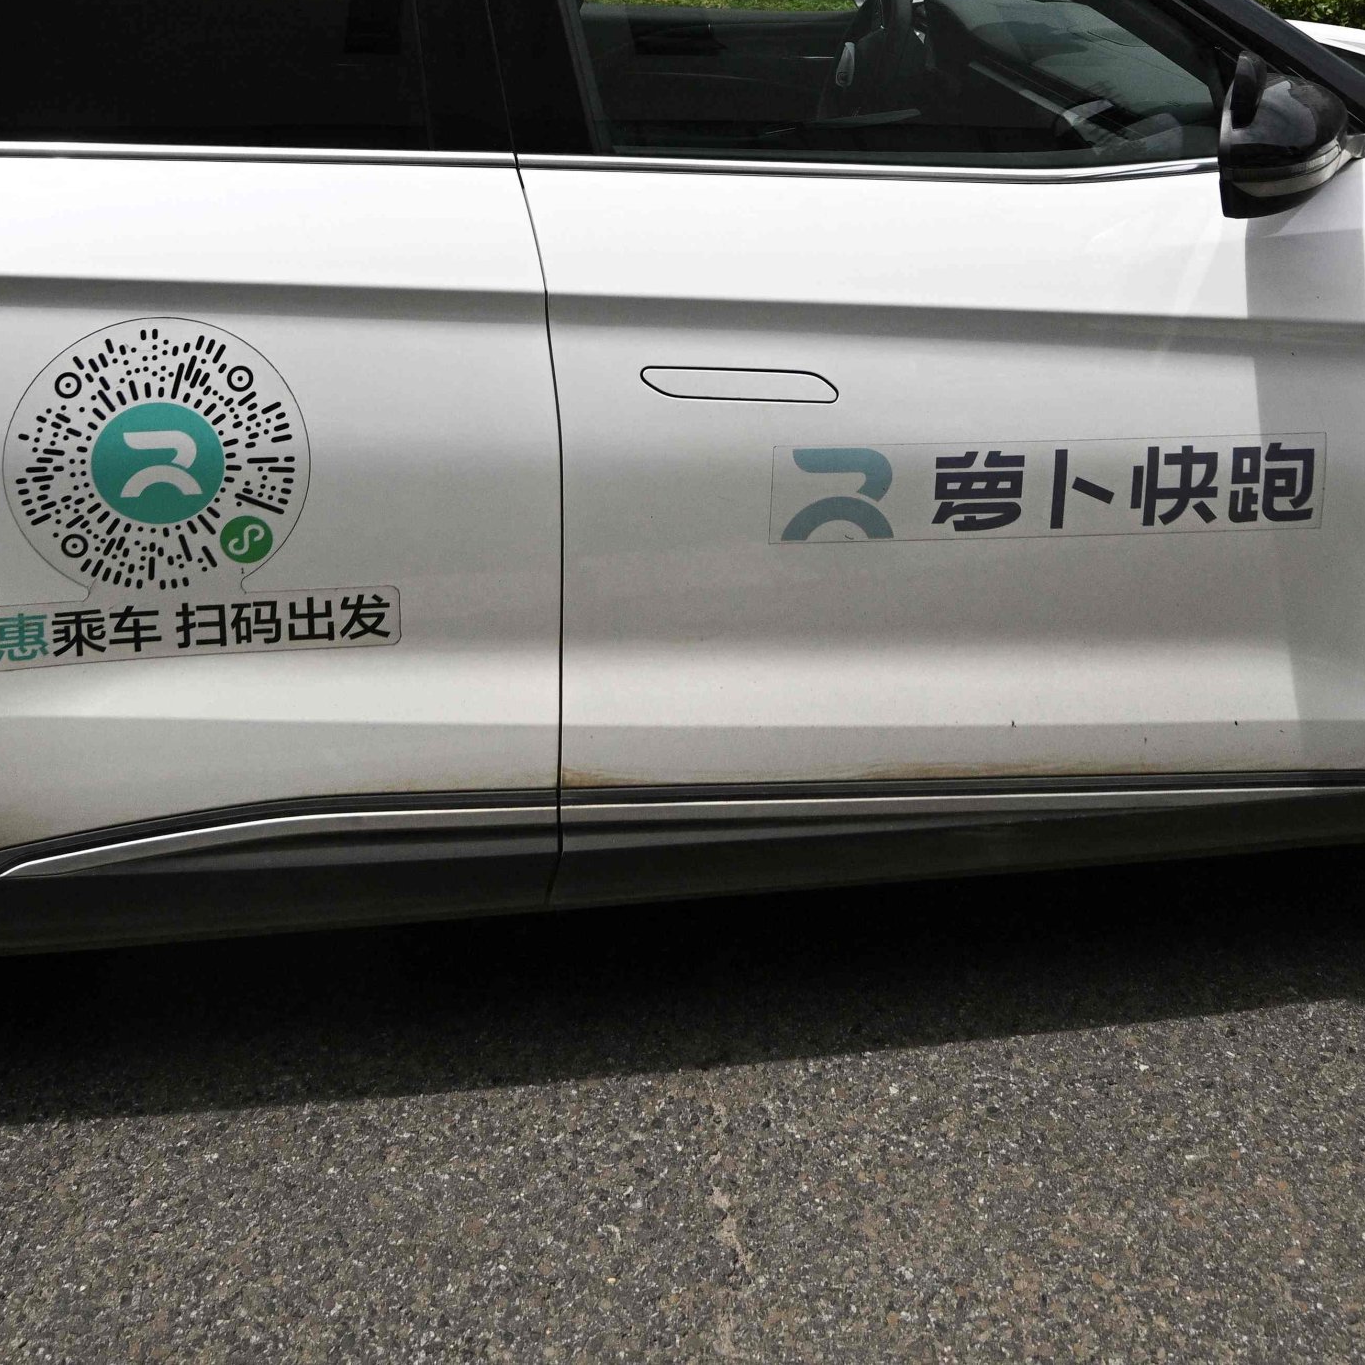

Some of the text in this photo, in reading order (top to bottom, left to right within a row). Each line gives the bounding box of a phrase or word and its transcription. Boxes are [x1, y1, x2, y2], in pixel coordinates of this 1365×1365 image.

[931, 441, 1316, 533] 萝卜快跑
[176, 594, 392, 649] 扫码出发
